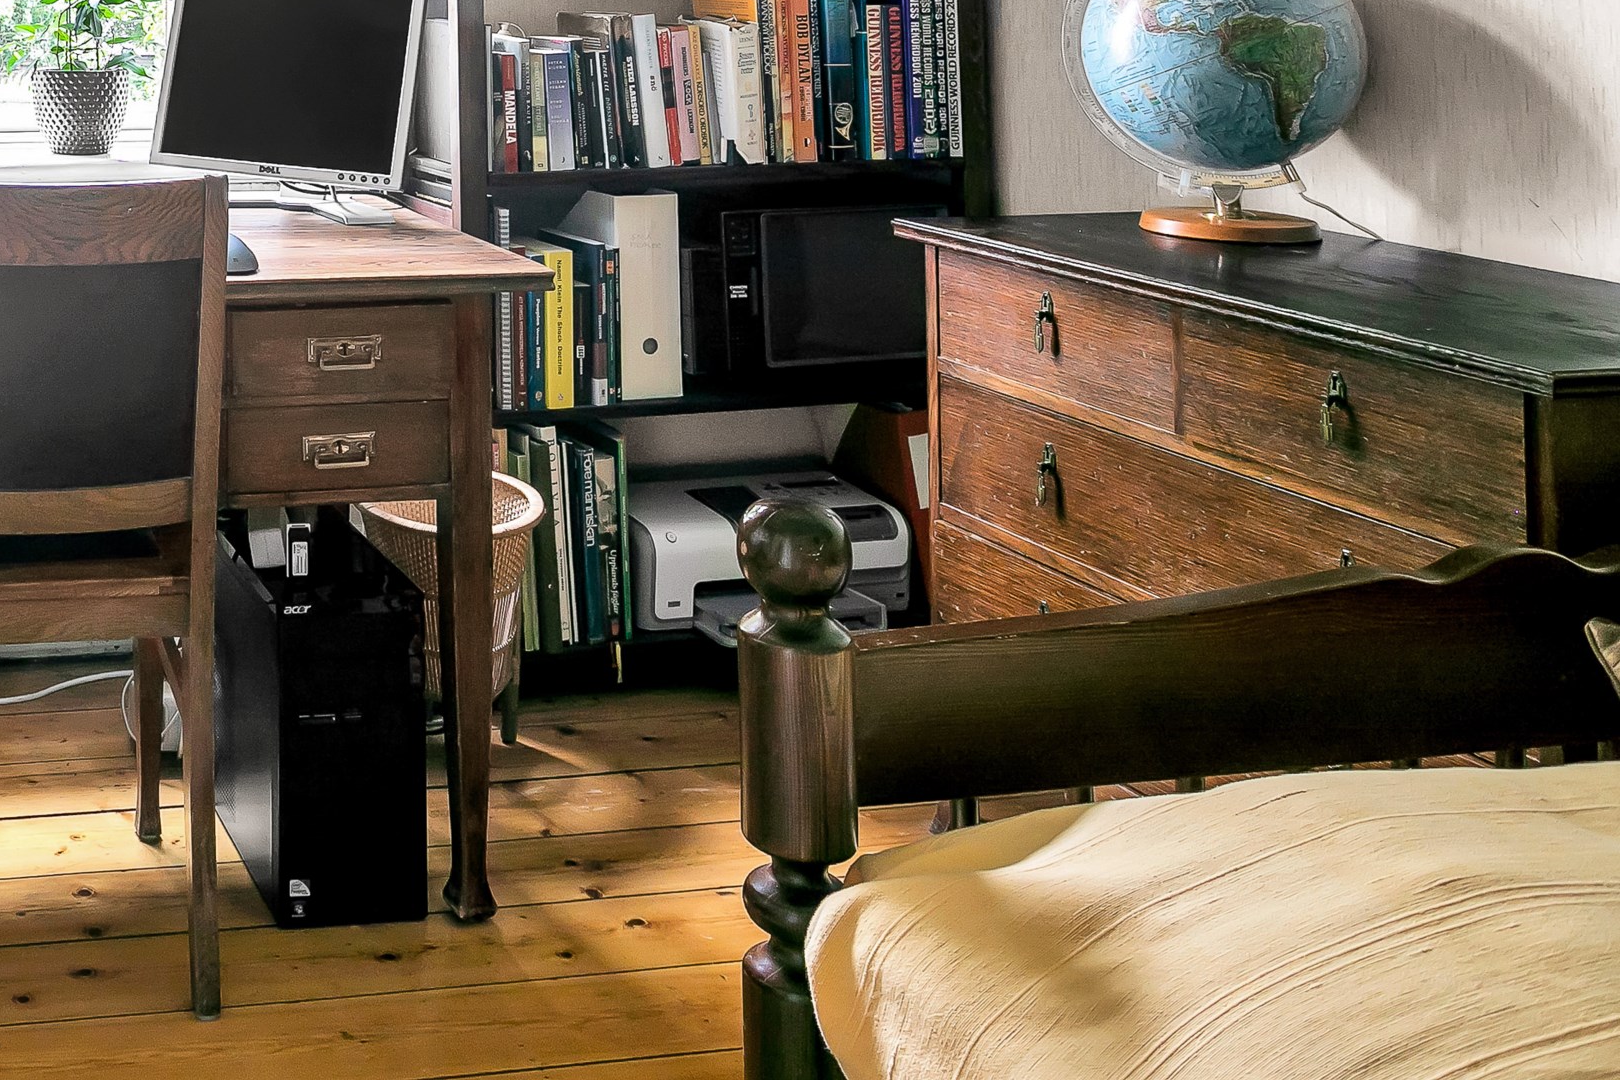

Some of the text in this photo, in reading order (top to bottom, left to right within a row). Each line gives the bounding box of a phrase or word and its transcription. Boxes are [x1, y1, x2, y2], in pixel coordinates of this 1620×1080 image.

[761, 23, 771, 76] MYTHOLOGY
[796, 14, 811, 83] BOB DYLAN
[811, 17, 819, 53] SVENSKA
[888, 7, 903, 71] GUINNESS
[910, 21, 921, 75] REKORDBOK
[922, 15, 933, 46] WORLD
[934, 22, 944, 57] WORLD
[947, 13, 957, 59] RECORDS
[574, 51, 583, 96] Americanah
[601, 54, 609, 78] HARPER
[649, 75, 657, 92] snö
[814, 55, 822, 98] HISTORIEN
[867, 8, 885, 153] GUINNESS REKORDBOK
[912, 77, 923, 99] 2001
[923, 47, 935, 86] RECORDS
[937, 60, 946, 104] RECORDS
[948, 61, 958, 98] WORLD
[625, 56, 640, 126] STIEG LARSSON
[681, 47, 694, 133] BONNIERS ROCK LEXIKON
[696, 81, 705, 116] KORSORD
[924, 88, 936, 133] 2002
[504, 90, 517, 144] MANDELA
[700, 118, 709, 149] ORDBOK
[939, 107, 948, 131] 2004
[949, 99, 960, 150] GUINNESS
[259, 165, 281, 174] DELL
[548, 439, 561, 527] BOLIVIA
[584, 481, 597, 547] människan
[609, 550, 620, 614] Upplands fåglar
[284, 605, 311, 614] acer
